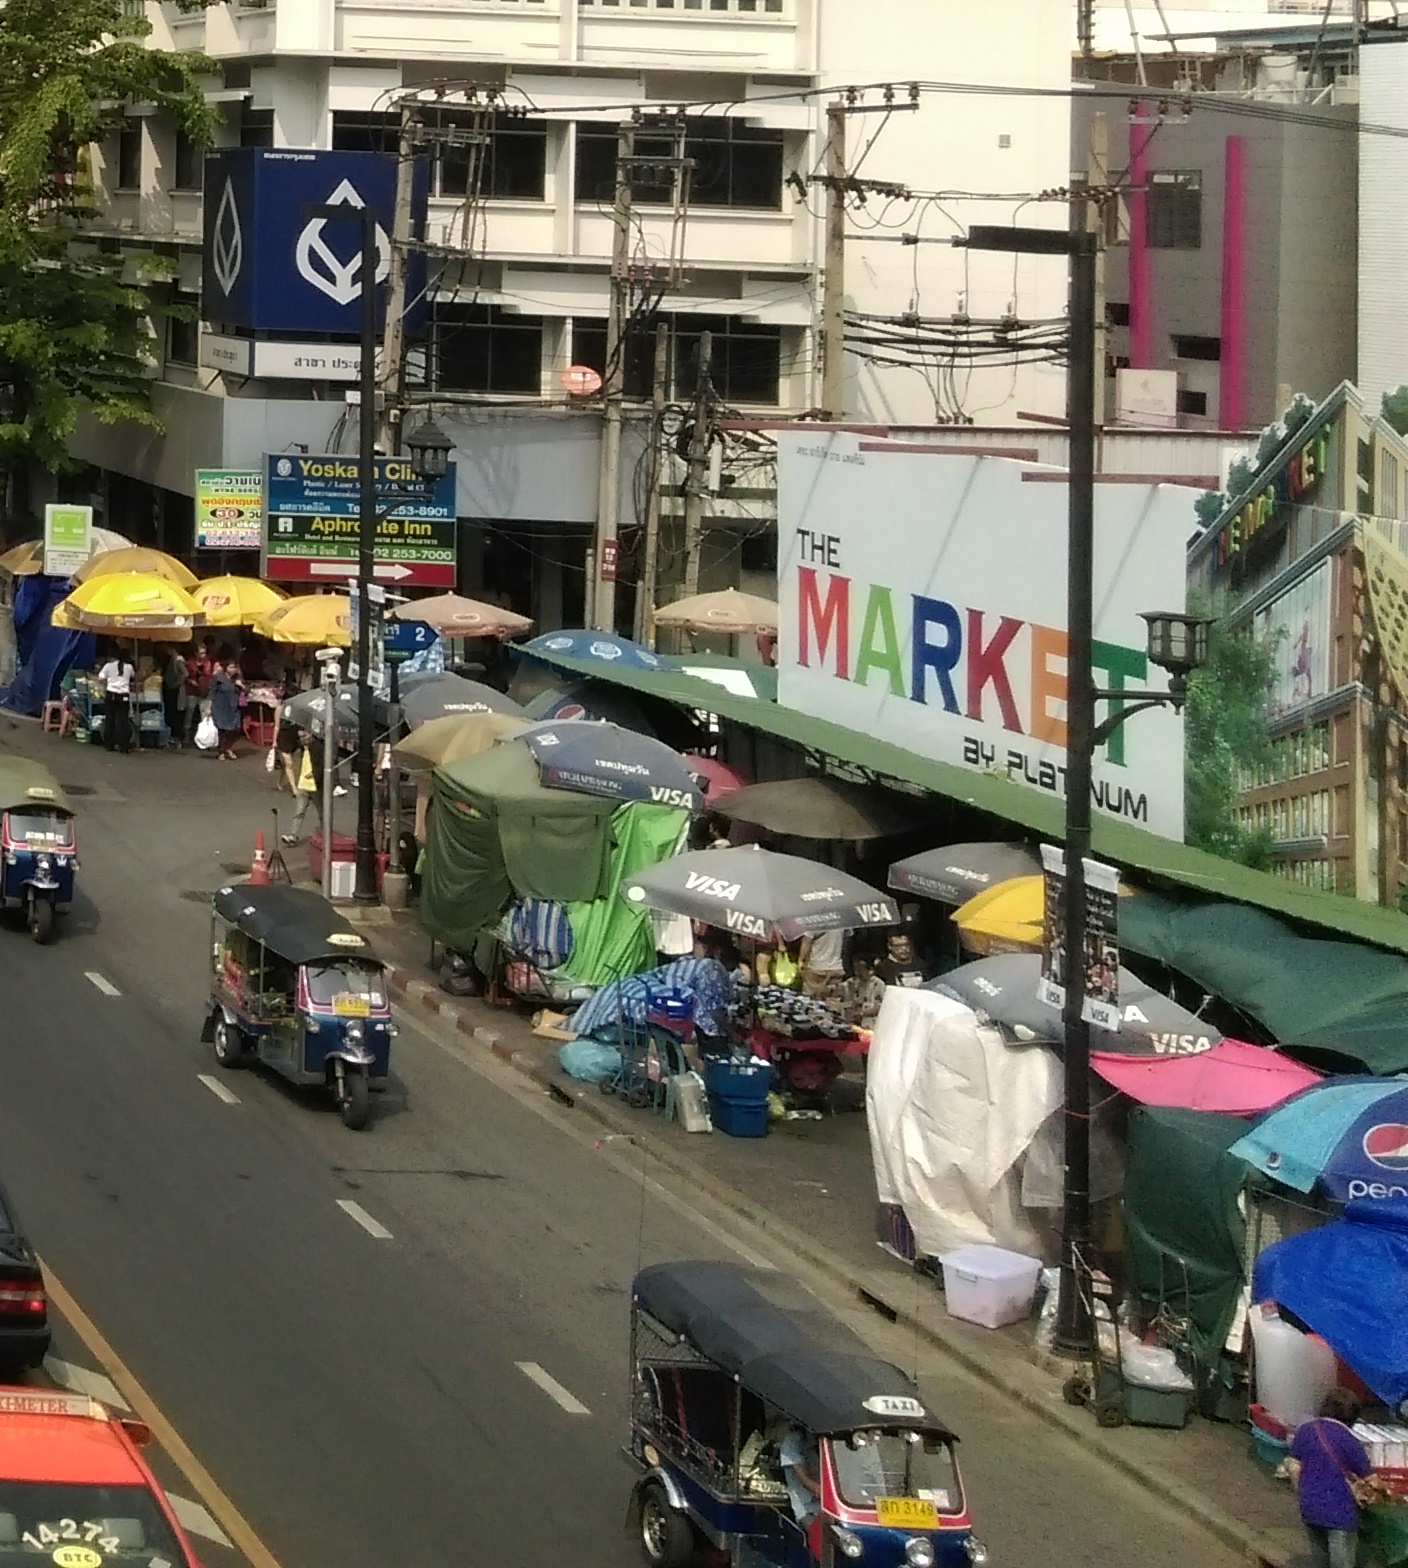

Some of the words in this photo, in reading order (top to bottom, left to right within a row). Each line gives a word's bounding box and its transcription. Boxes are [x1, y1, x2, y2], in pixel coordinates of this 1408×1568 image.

[404, 520, 433, 536] Inn
[392, 549, 452, 561] 253-7000
[796, 528, 841, 568] THE
[415, 626, 426, 641] 2
[796, 565, 1148, 768] MARKET
[649, 785, 694, 809] VISA
[684, 871, 742, 901] VISA
[725, 908, 767, 938] VISA
[856, 902, 893, 924] VISA
[1149, 1032, 1211, 1054] VISA
[881, 1399, 916, 1412] TAXI
[21, 1518, 121, 1554] 14274
[62, 1552, 95, 1563] BTC
